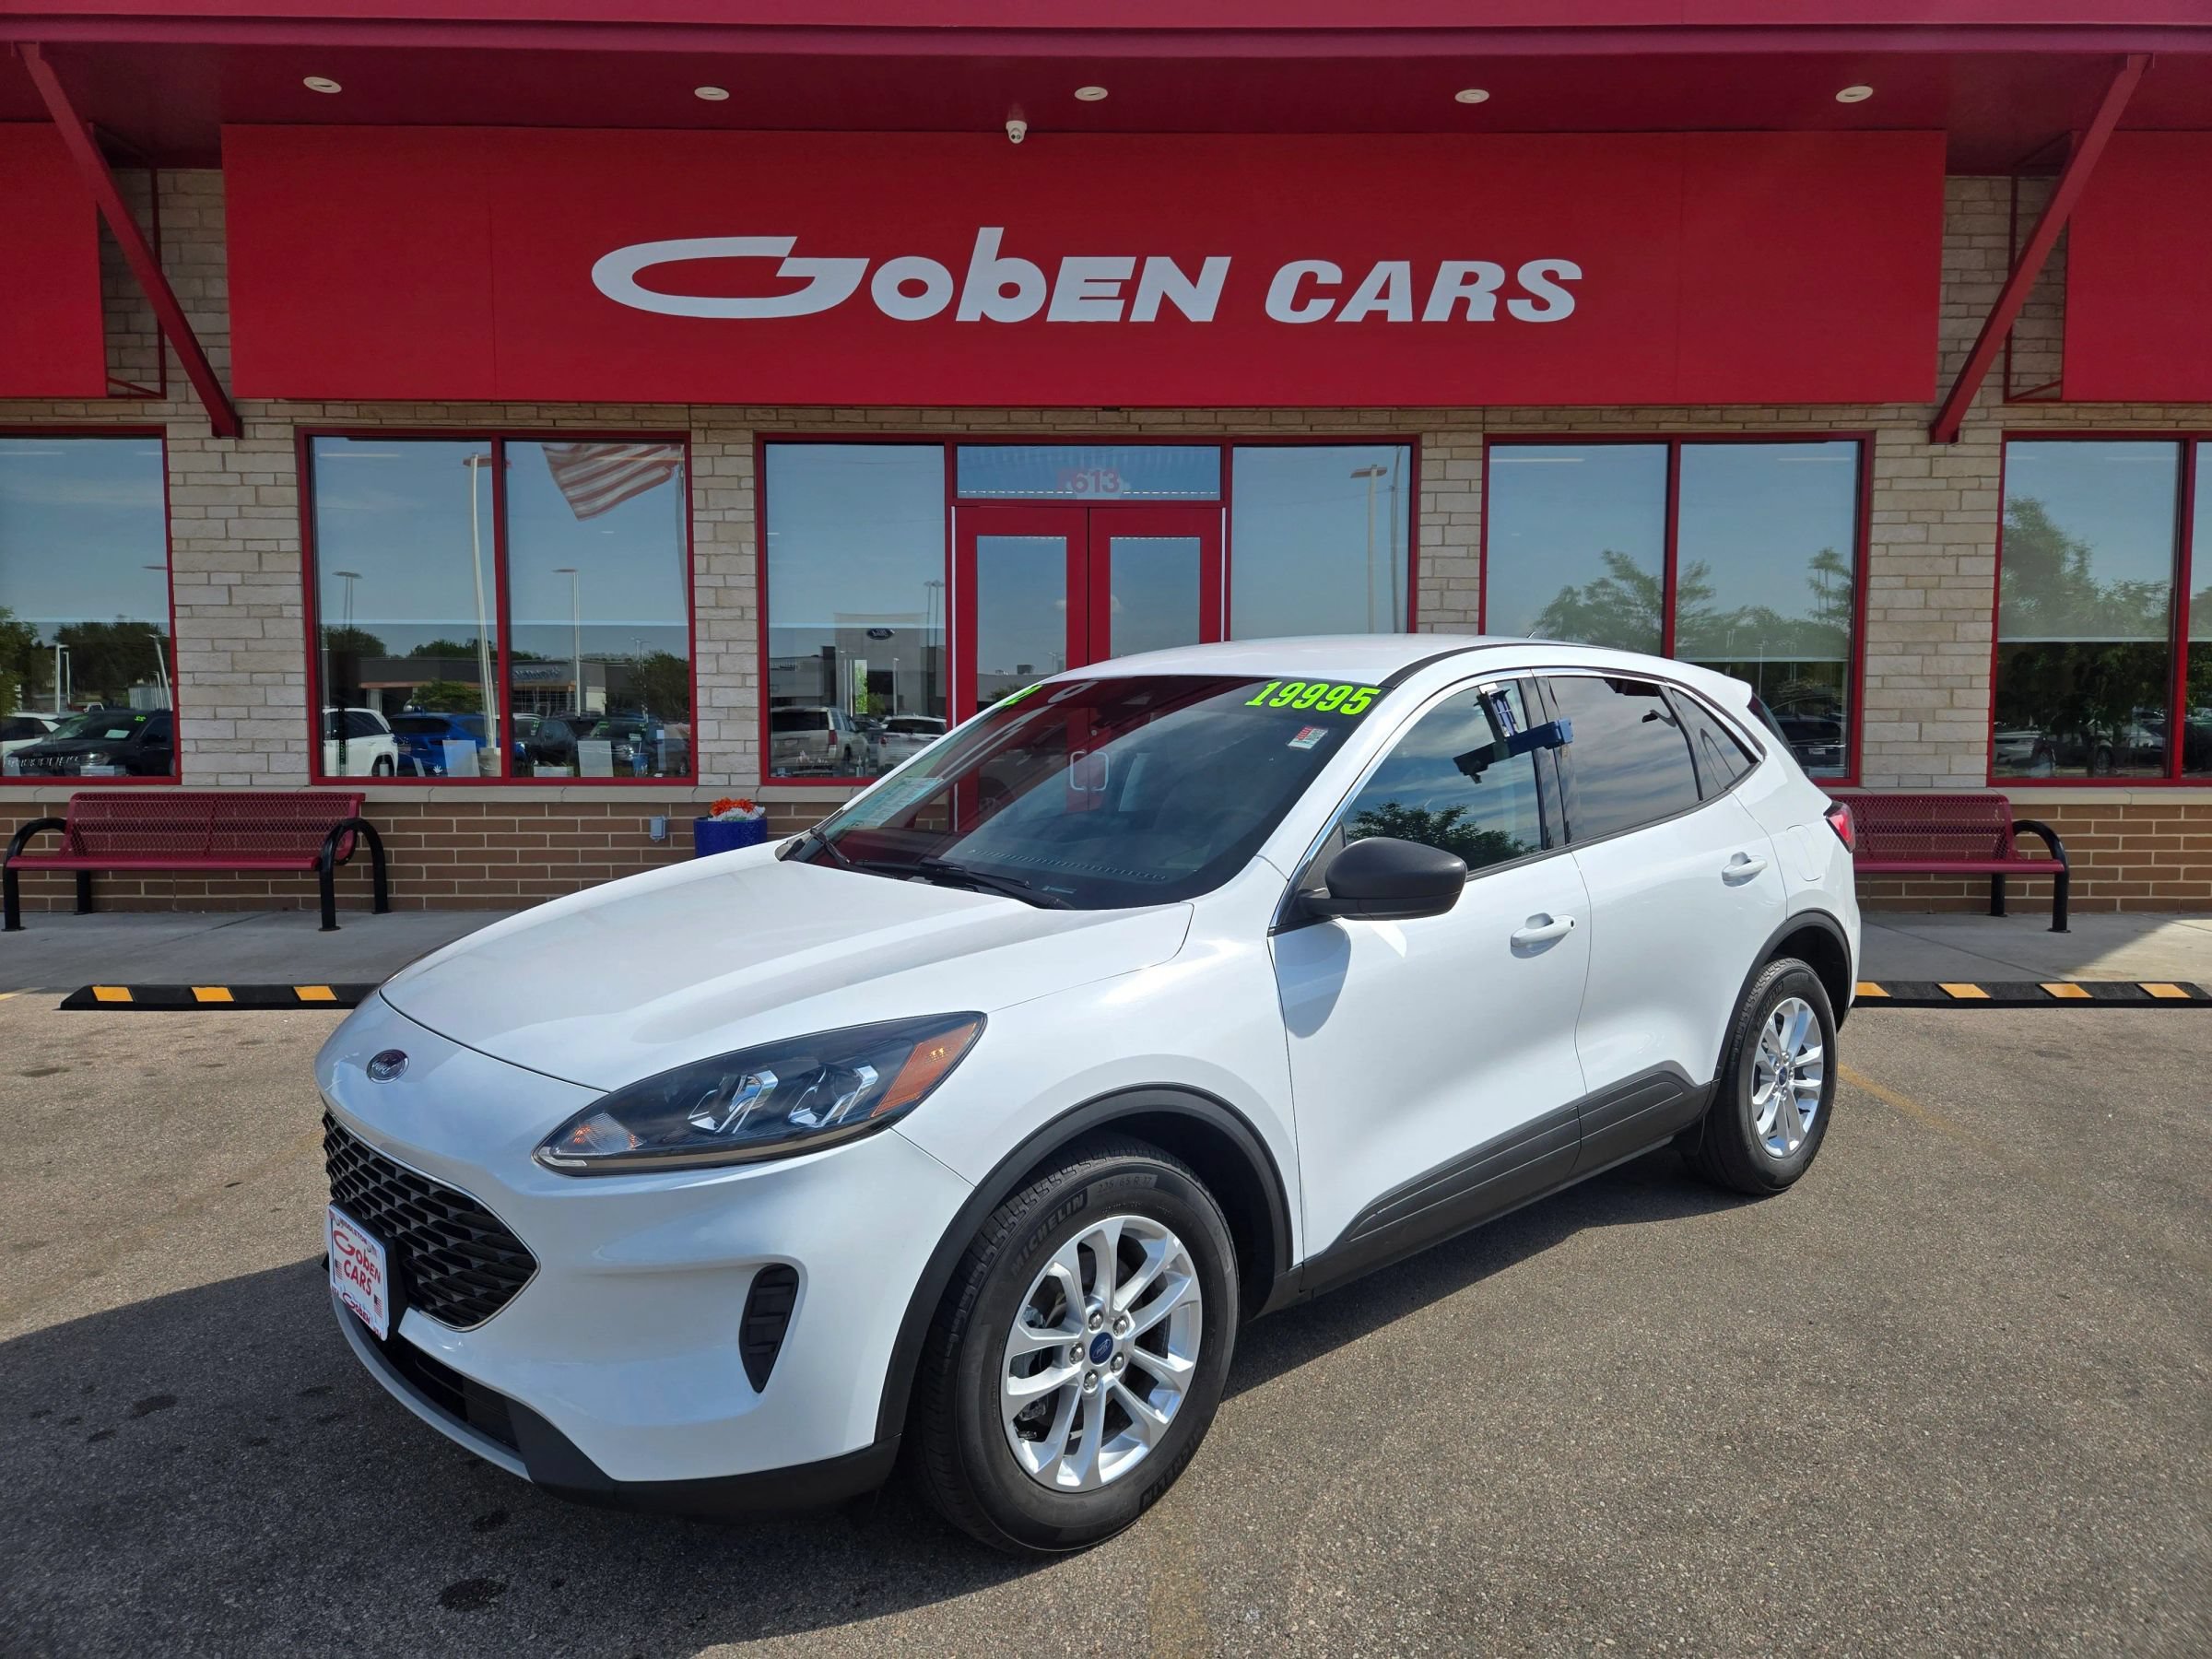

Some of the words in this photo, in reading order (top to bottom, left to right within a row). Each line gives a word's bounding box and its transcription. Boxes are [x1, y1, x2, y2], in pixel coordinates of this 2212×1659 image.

[1265, 259, 1583, 324] CARS
[1245, 681, 1382, 716] 19995
[1012, 1191, 1086, 1274] MICHELIN
[344, 1259, 372, 1296] CARS
